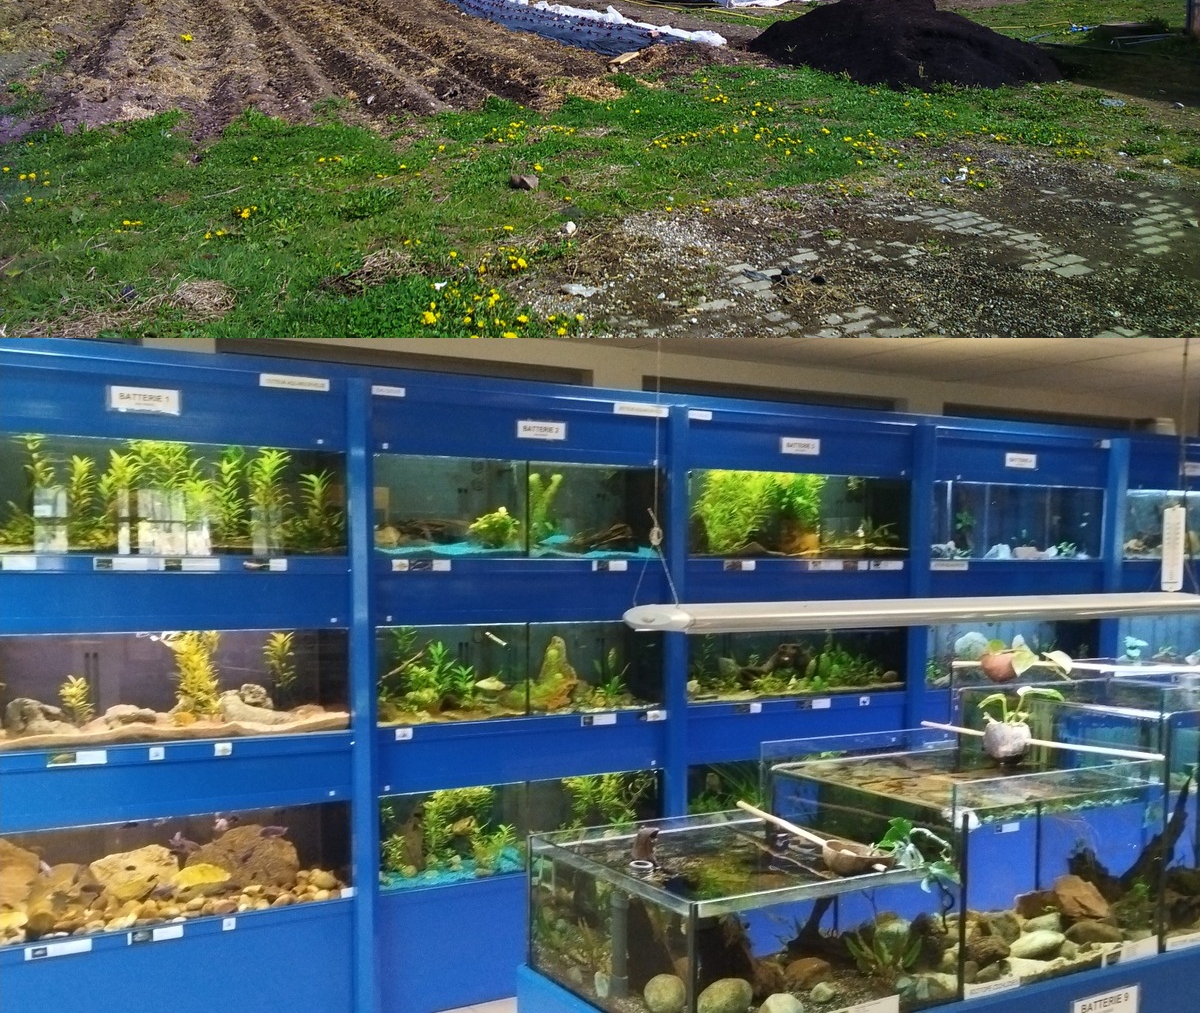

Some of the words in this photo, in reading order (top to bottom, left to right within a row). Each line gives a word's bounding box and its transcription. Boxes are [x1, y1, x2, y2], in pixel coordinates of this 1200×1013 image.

[119, 392, 163, 403] BATTERIE
[523, 425, 554, 433] BATTERIE
[1081, 993, 1122, 1013] BATTERIE
[1124, 992, 1130, 1002] 9
